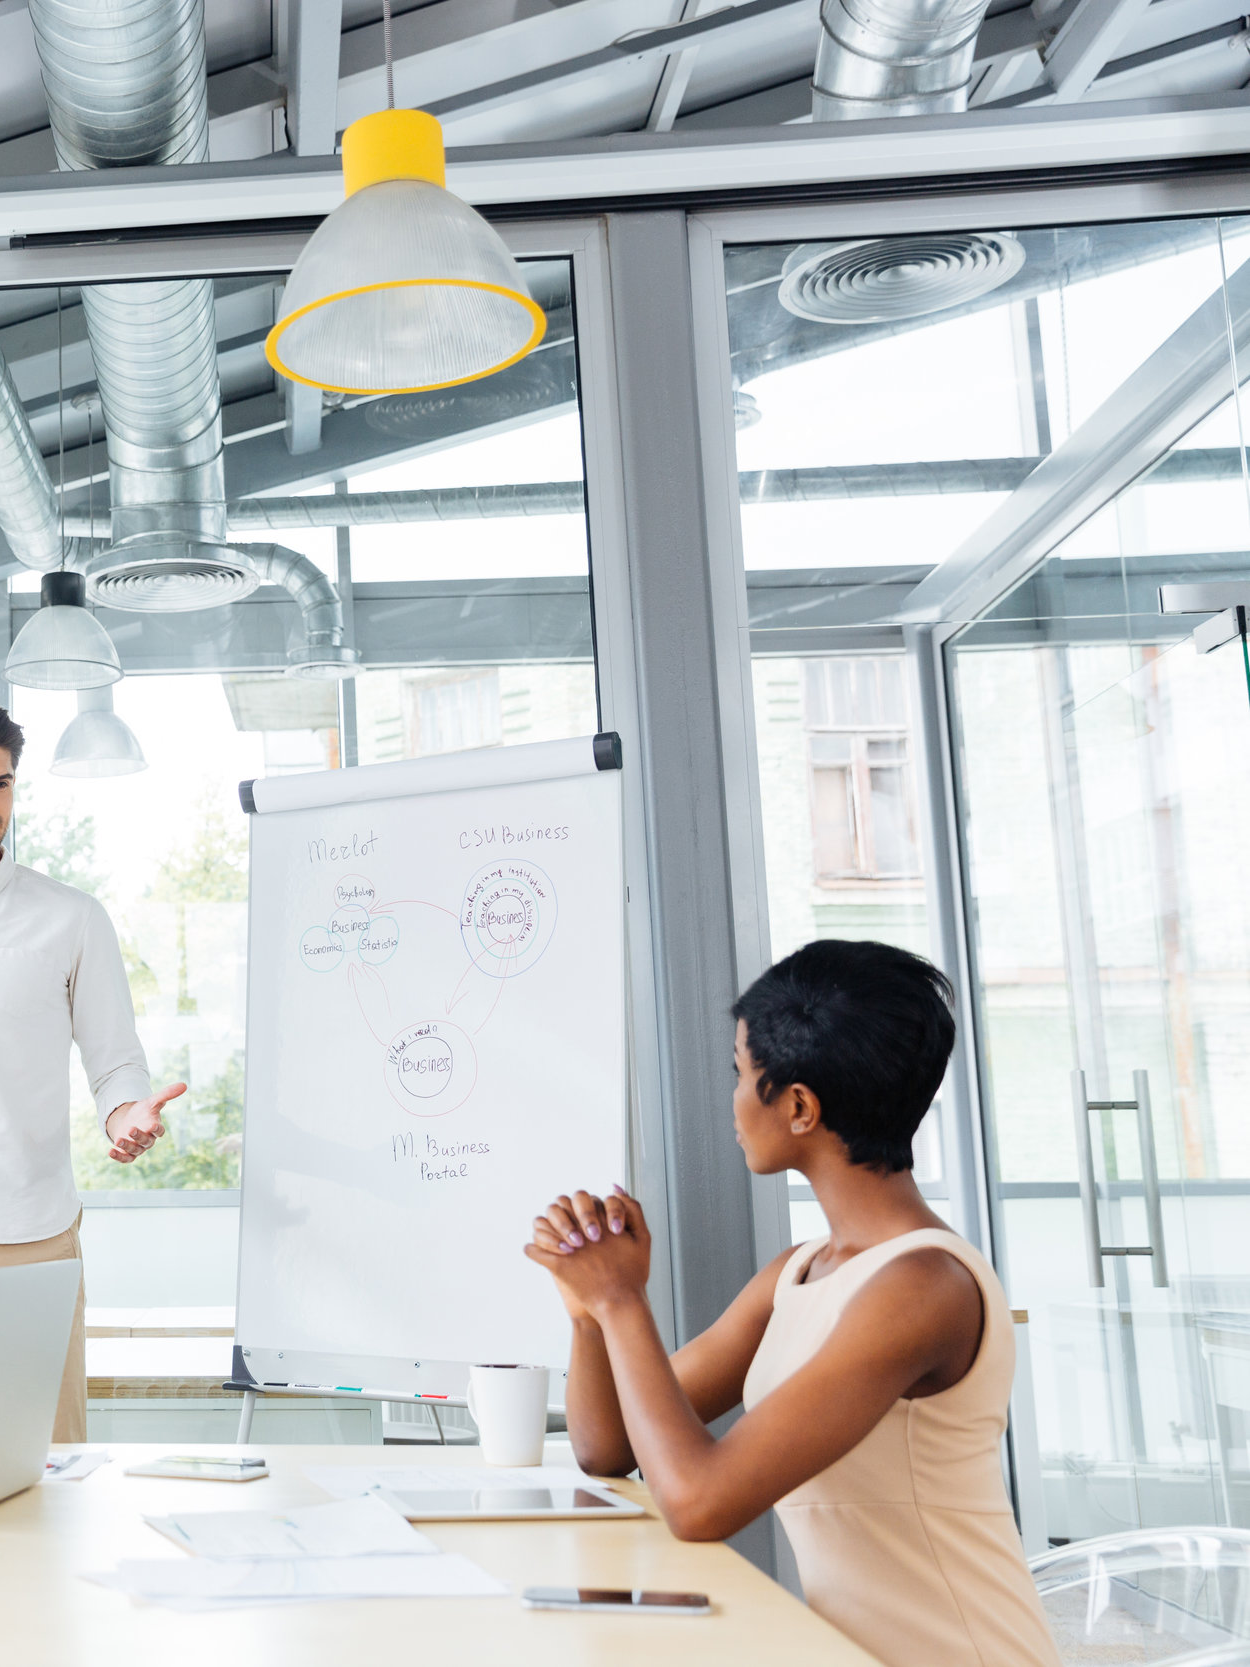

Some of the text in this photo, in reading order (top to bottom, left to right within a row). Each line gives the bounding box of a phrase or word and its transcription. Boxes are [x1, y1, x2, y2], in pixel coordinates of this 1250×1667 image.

[307, 829, 379, 863] Merlot
[459, 822, 569, 849] CSU Business
[461, 883, 485, 927] Teaching
[490, 869, 502, 878] my
[508, 866, 546, 898] institution
[476, 891, 501, 928] Teaching
[512, 888, 524, 899] my
[331, 920, 370, 934] Business
[487, 911, 525, 926] Business
[303, 942, 343, 955] Economics
[387, 1039, 407, 1065] What
[402, 1055, 451, 1074] Business
[392, 1131, 491, 1162] M. Business
[420, 1161, 469, 1181] Portal
